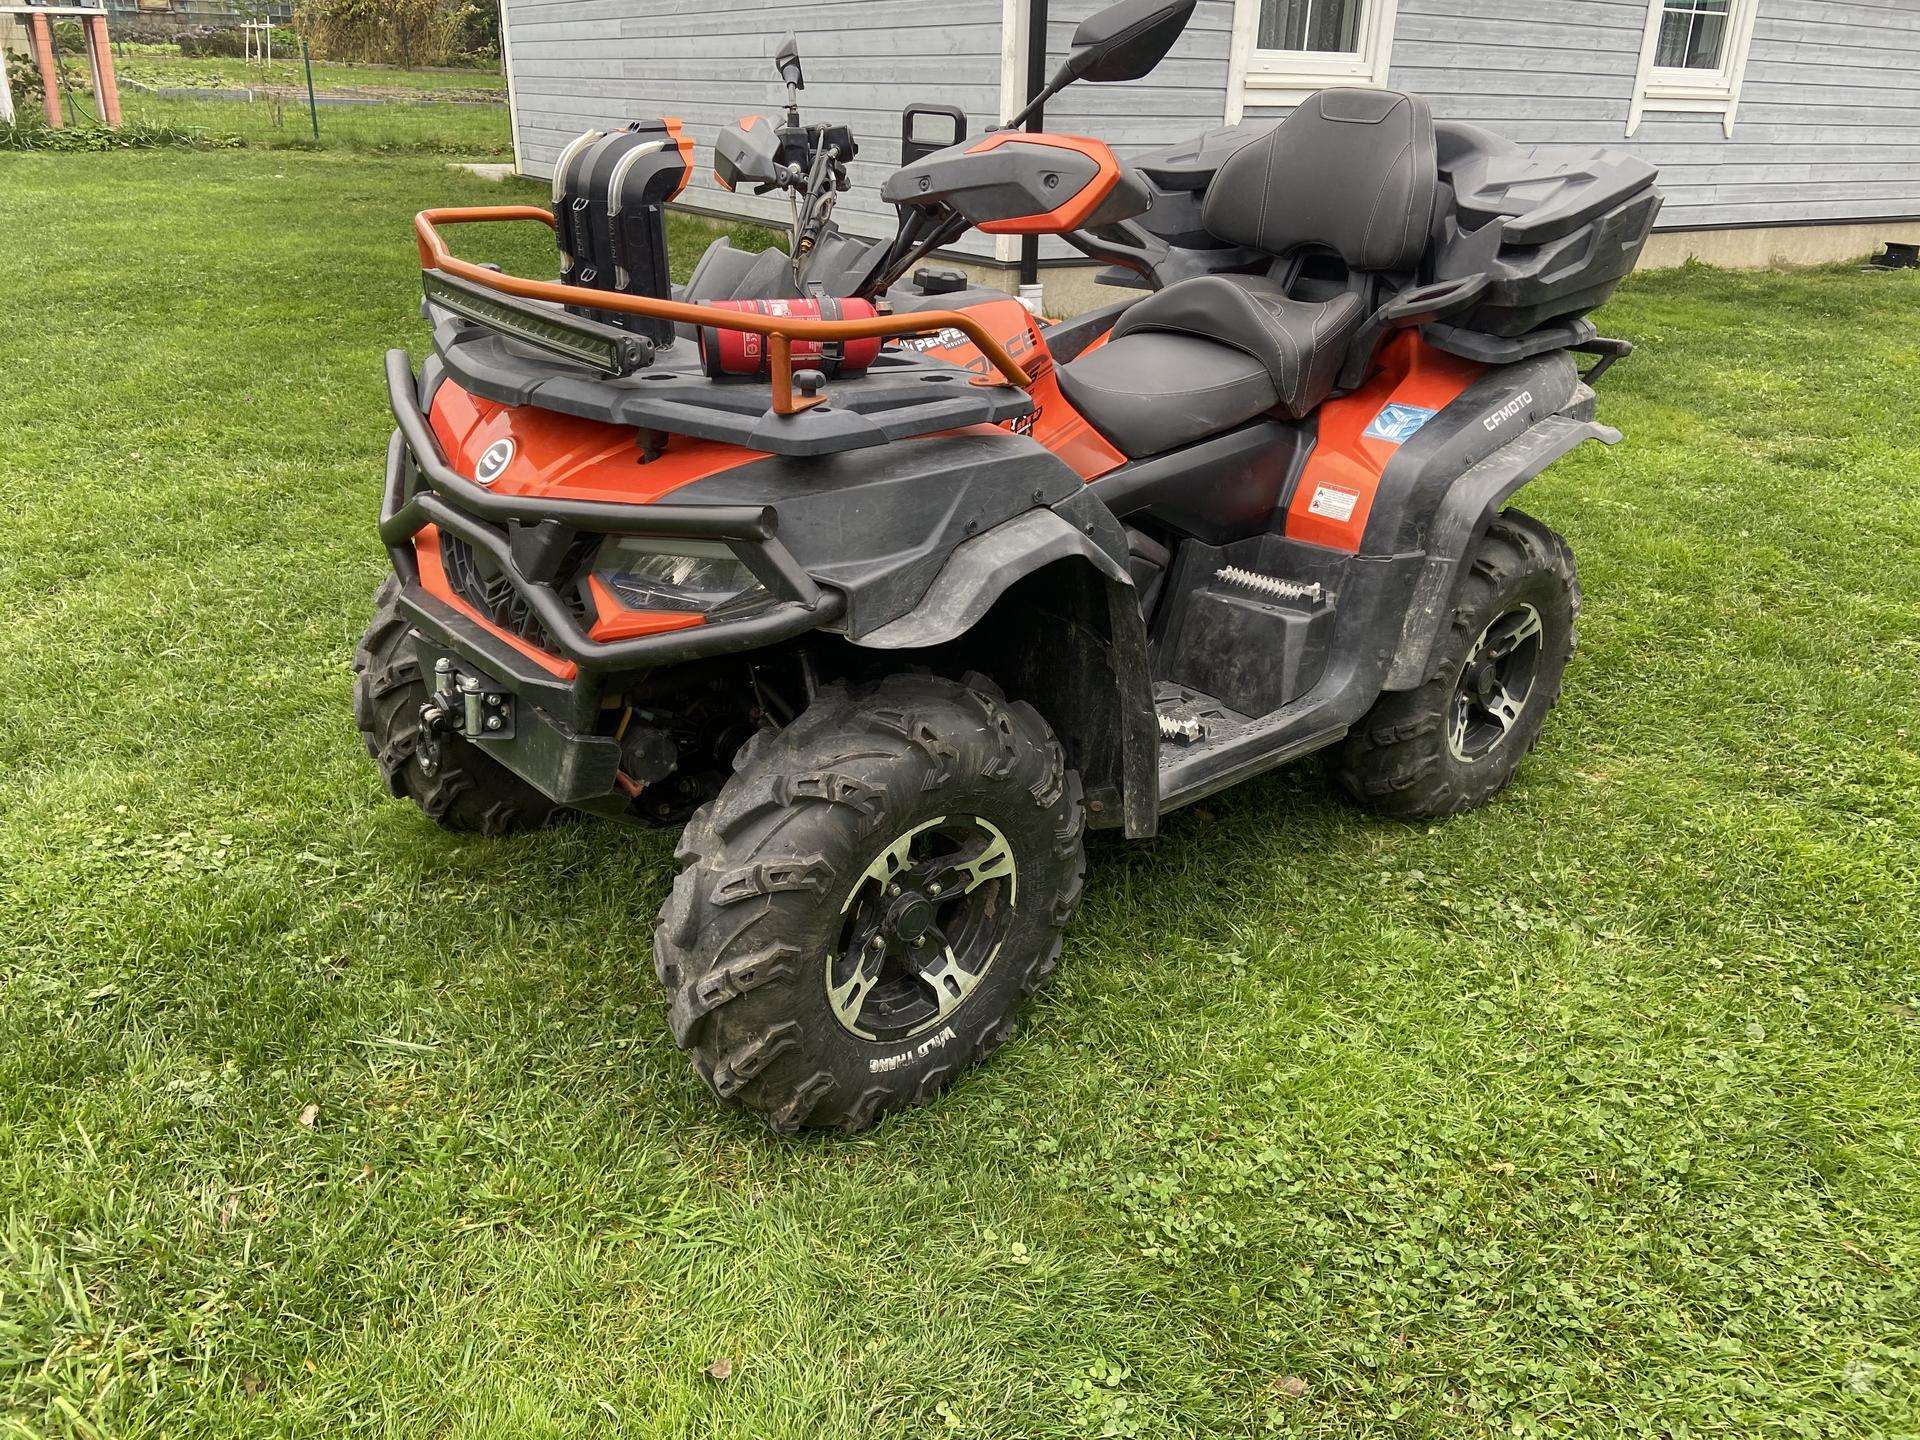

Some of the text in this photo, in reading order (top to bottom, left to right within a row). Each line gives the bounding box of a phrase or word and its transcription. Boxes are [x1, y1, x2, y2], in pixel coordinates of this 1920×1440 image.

[1483, 391, 1533, 431] CFMOTO
[869, 1026, 957, 1074] WILD THANG
